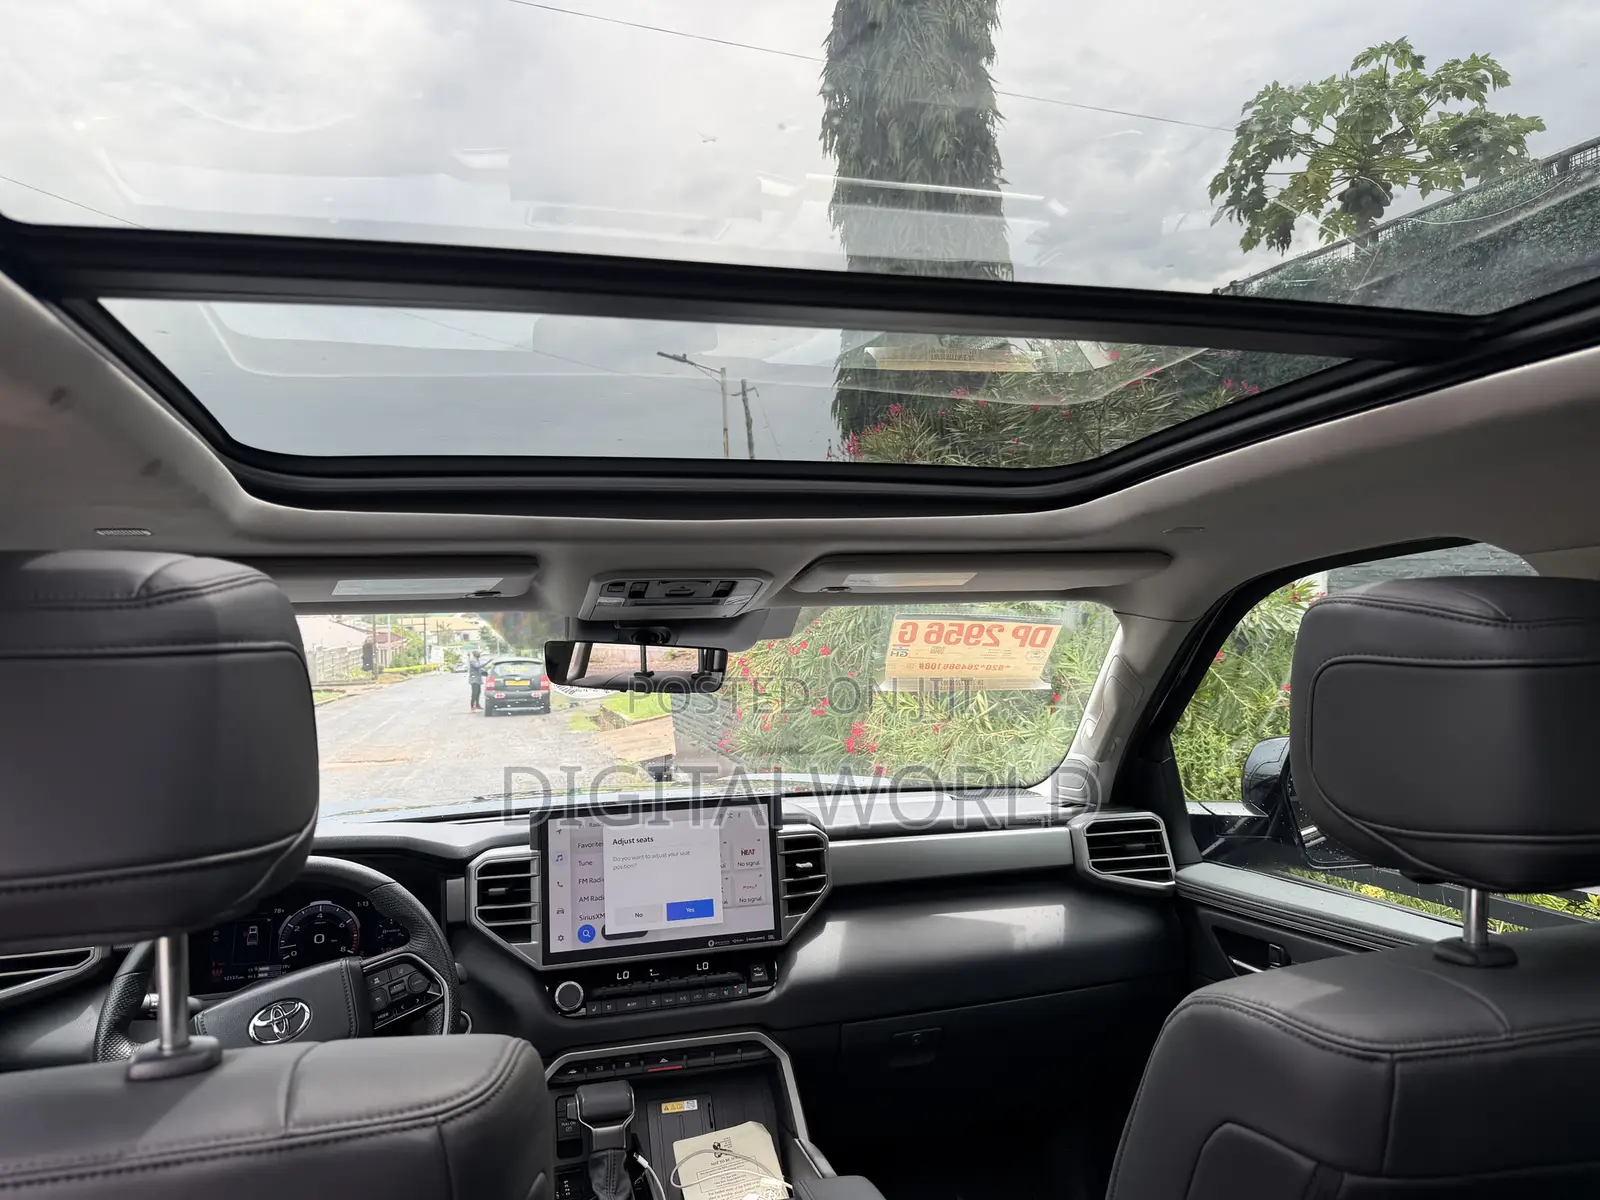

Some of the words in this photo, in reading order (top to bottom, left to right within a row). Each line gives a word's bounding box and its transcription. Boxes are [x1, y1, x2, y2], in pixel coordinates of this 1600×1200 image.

[612, 838, 635, 847] Adjust
[636, 836, 654, 844] seats
[651, 852, 668, 860] adjust
[740, 848, 756, 857] HEAT
[612, 862, 637, 871] position?
[745, 859, 760, 868] signal
[588, 876, 605, 884] Radi
[357, 900, 370, 908] 1:13
[746, 895, 762, 904] signal
[579, 912, 606, 922] SiriusXM
[313, 933, 325, 945] 0
